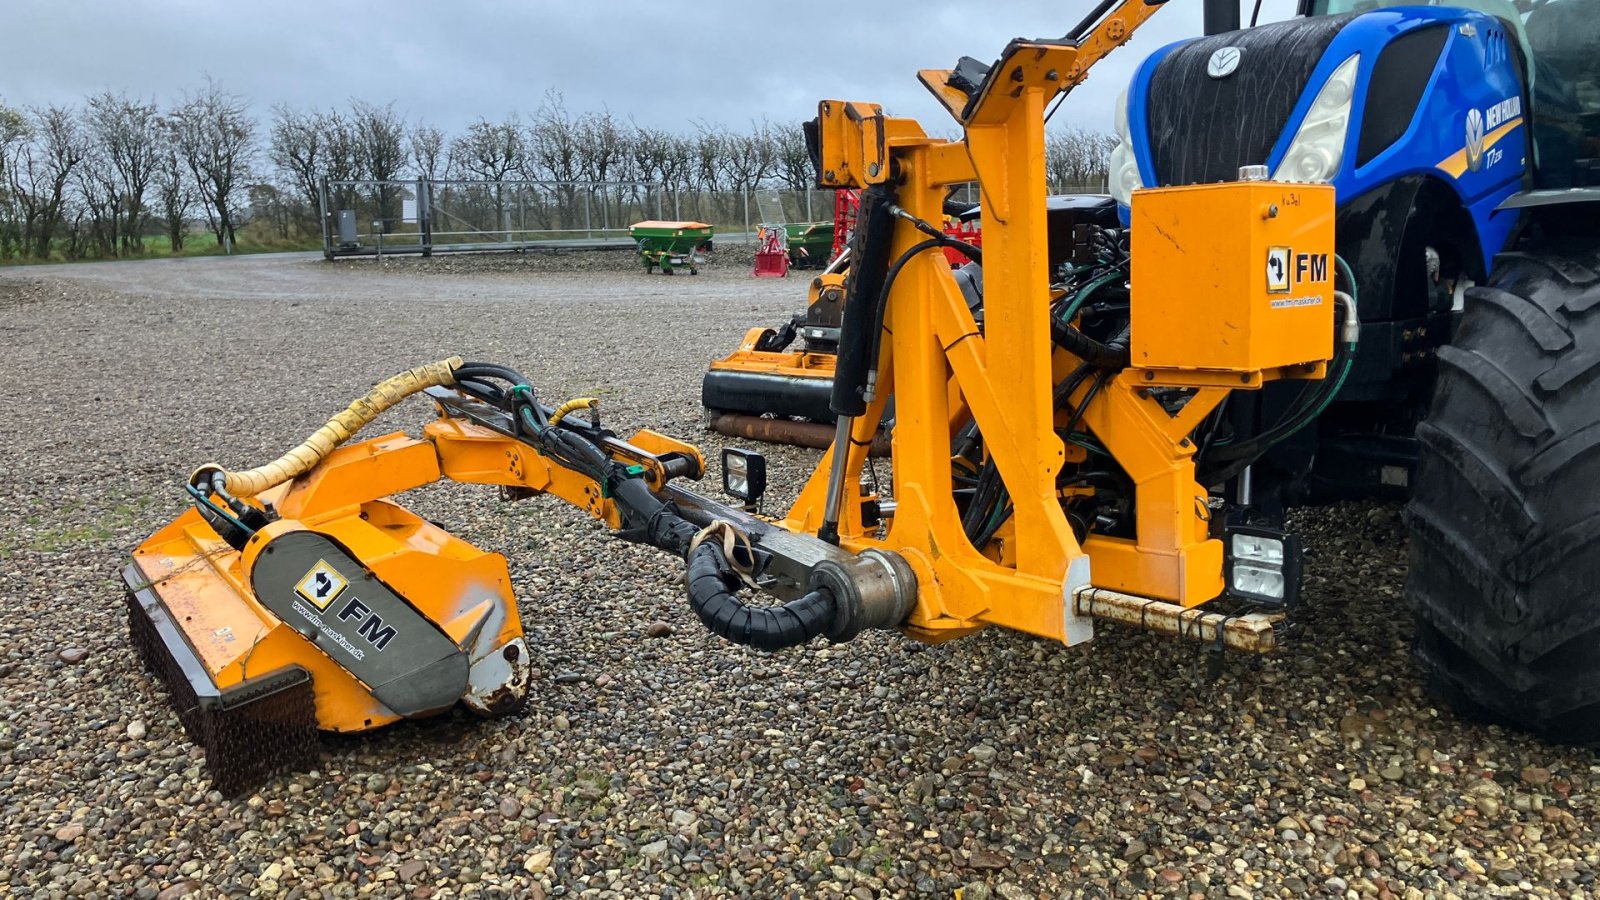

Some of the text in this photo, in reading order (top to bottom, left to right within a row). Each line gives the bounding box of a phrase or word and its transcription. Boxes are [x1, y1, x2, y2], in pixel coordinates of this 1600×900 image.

[1486, 102, 1501, 130] NEW
[1295, 253, 1328, 283] FM
[292, 600, 365, 660] www.fm-maskiner.dk
[337, 597, 398, 651] FM
